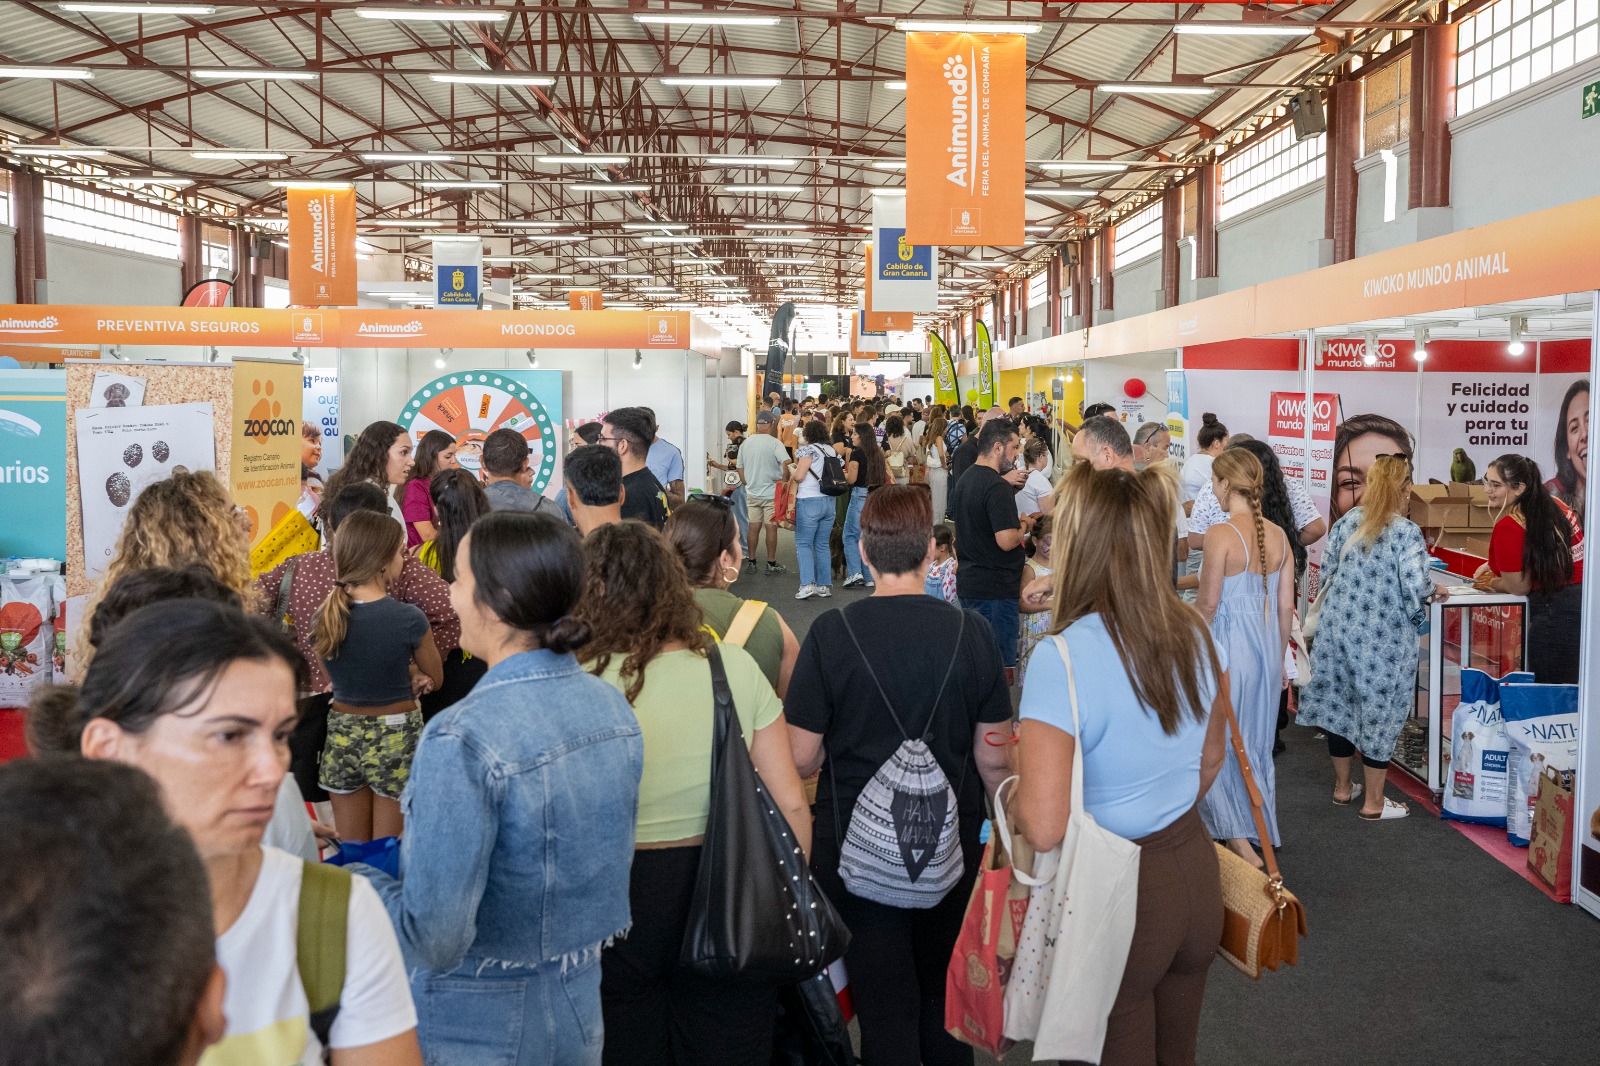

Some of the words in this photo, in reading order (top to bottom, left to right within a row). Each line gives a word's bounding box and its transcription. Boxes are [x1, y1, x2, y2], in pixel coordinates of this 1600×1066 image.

[982, 46, 990, 94] COMPAÑÍA
[982, 97, 990, 110] DE
[944, 55, 968, 187] Animundo
[308, 199, 323, 273] Animundo
[1364, 273, 1404, 298] KIWOKO
[1407, 262, 1451, 290] MUNDO
[1454, 252, 1510, 282] ANIMAL
[0, 316, 58, 328] nimundo
[97, 320, 186, 332] PREVENTIVA
[190, 321, 259, 332] SEGUROS
[358, 320, 422, 333] Animundo
[502, 324, 575, 336] MOONDOG
[1328, 358, 1362, 367] mundo
[1452, 383, 1530, 397] Felicidad
[438, 404, 454, 422] Snack
[1447, 403, 1456, 416] y
[1461, 400, 1529, 413] cuidado
[244, 419, 294, 436] zoocan
[1277, 418, 1302, 430] mundo
[1304, 420, 1330, 432] imal
[1466, 418, 1506, 433] para
[1511, 418, 1528, 430] tu
[1469, 432, 1528, 445] animal
[244, 454, 262, 463] Registro
[1311, 449, 1332, 461] egalo!
[237, 476, 298, 490] www.zoocan.net
